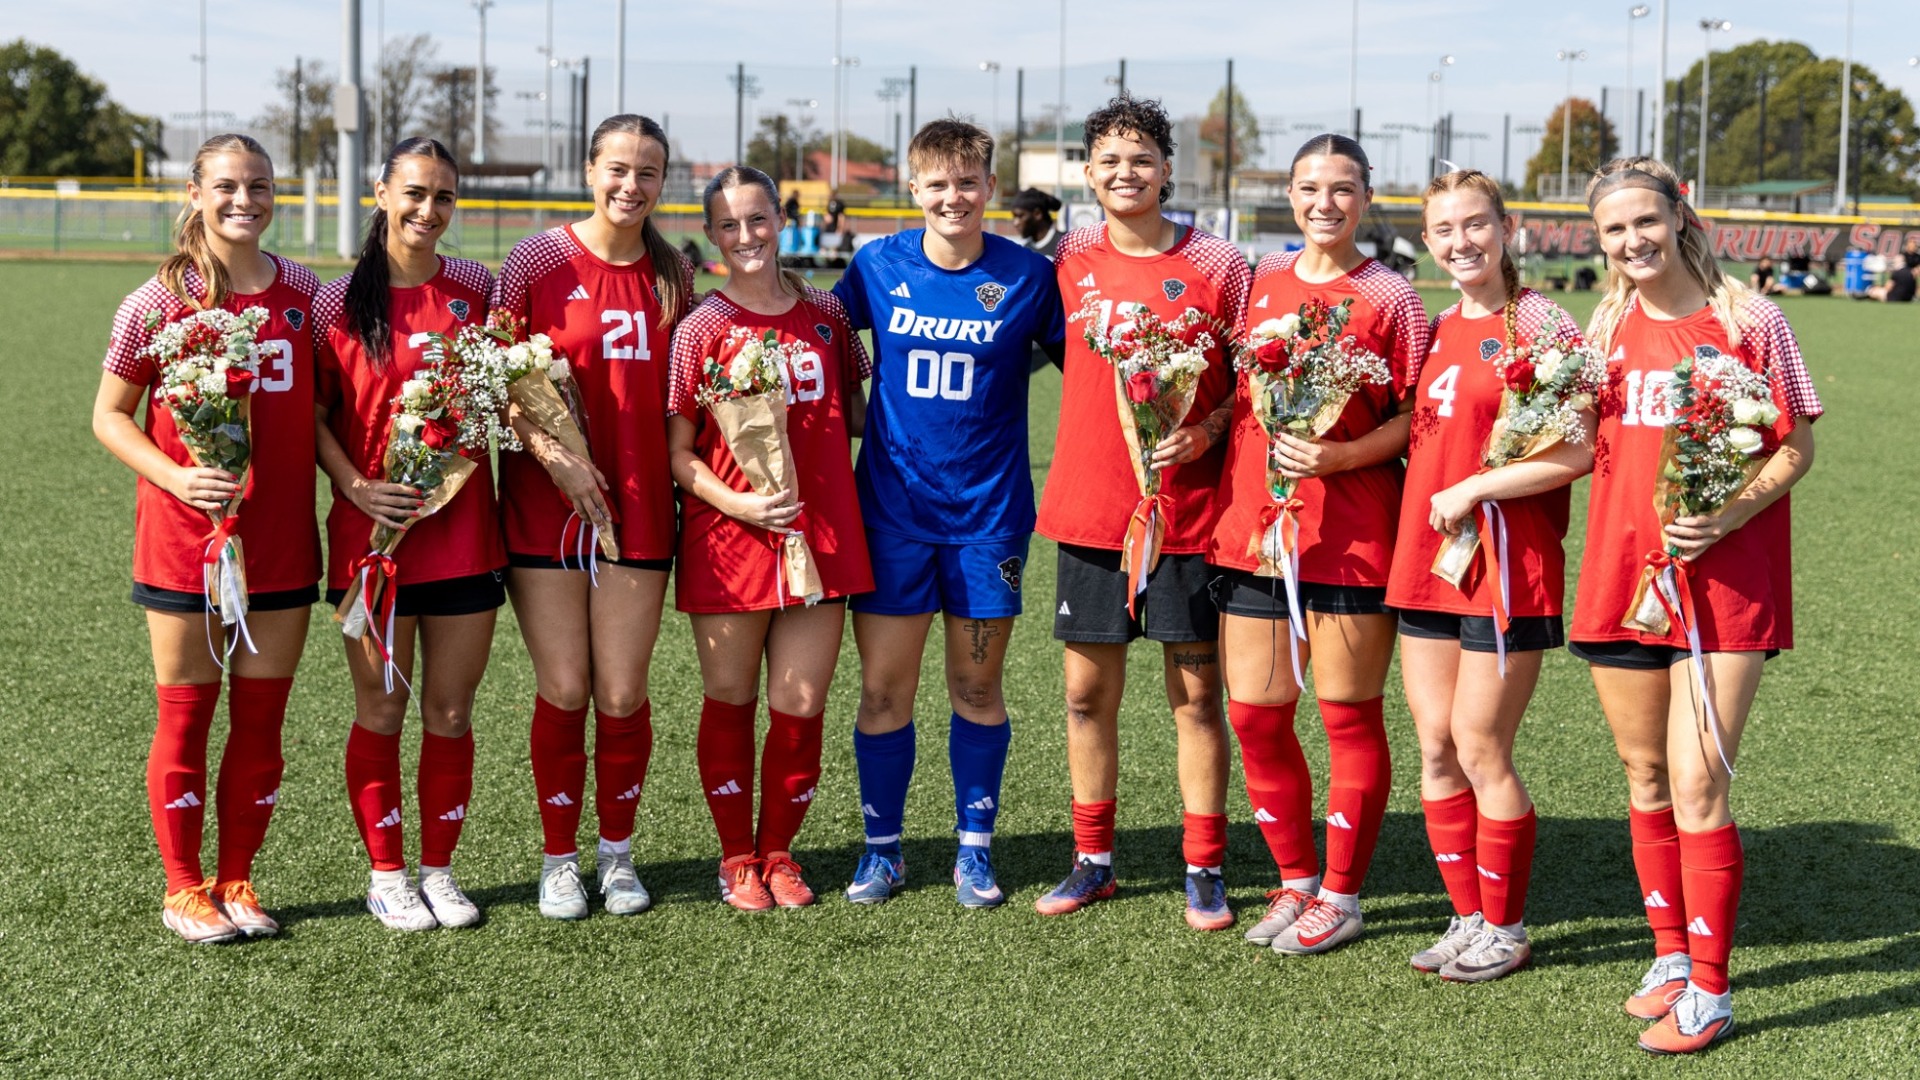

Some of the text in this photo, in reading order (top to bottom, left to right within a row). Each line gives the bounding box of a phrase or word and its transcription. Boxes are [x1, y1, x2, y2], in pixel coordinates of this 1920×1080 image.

[1702, 218, 1840, 262] RURY
[601, 309, 651, 361] 21
[887, 306, 1004, 345] DRURY
[906, 348, 975, 401] 00
[1427, 364, 1461, 418] 4
